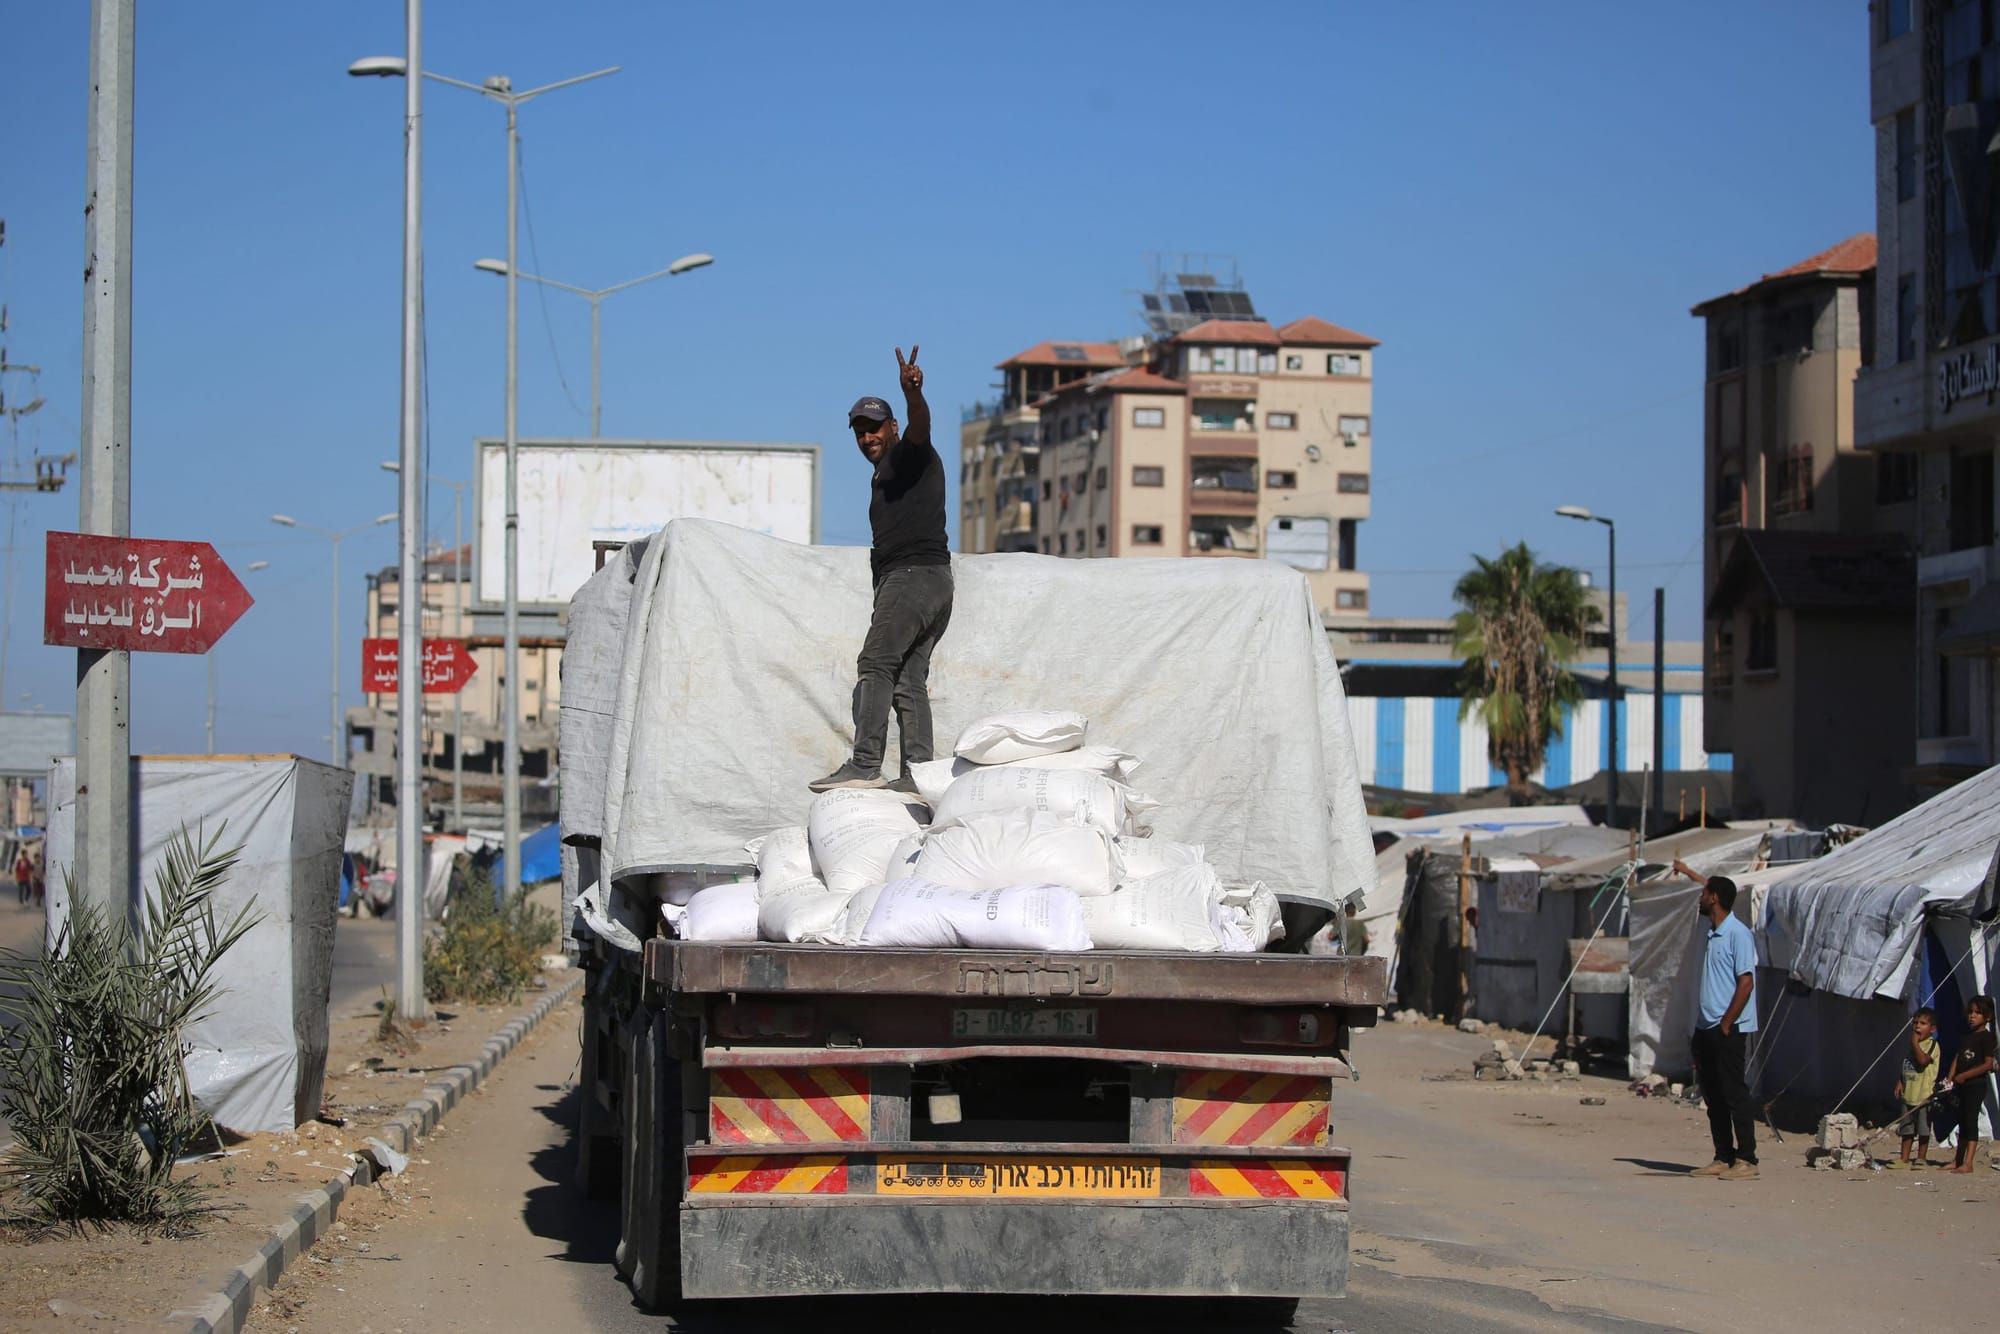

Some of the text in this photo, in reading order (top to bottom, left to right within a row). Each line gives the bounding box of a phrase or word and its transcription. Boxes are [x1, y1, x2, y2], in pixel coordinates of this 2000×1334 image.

[64, 554, 203, 597] شركة محمد
[64, 597, 201, 637] الزق للحديد
[985, 1164, 1029, 1194] ארוך
[1037, 1164, 1075, 1188] רכב
